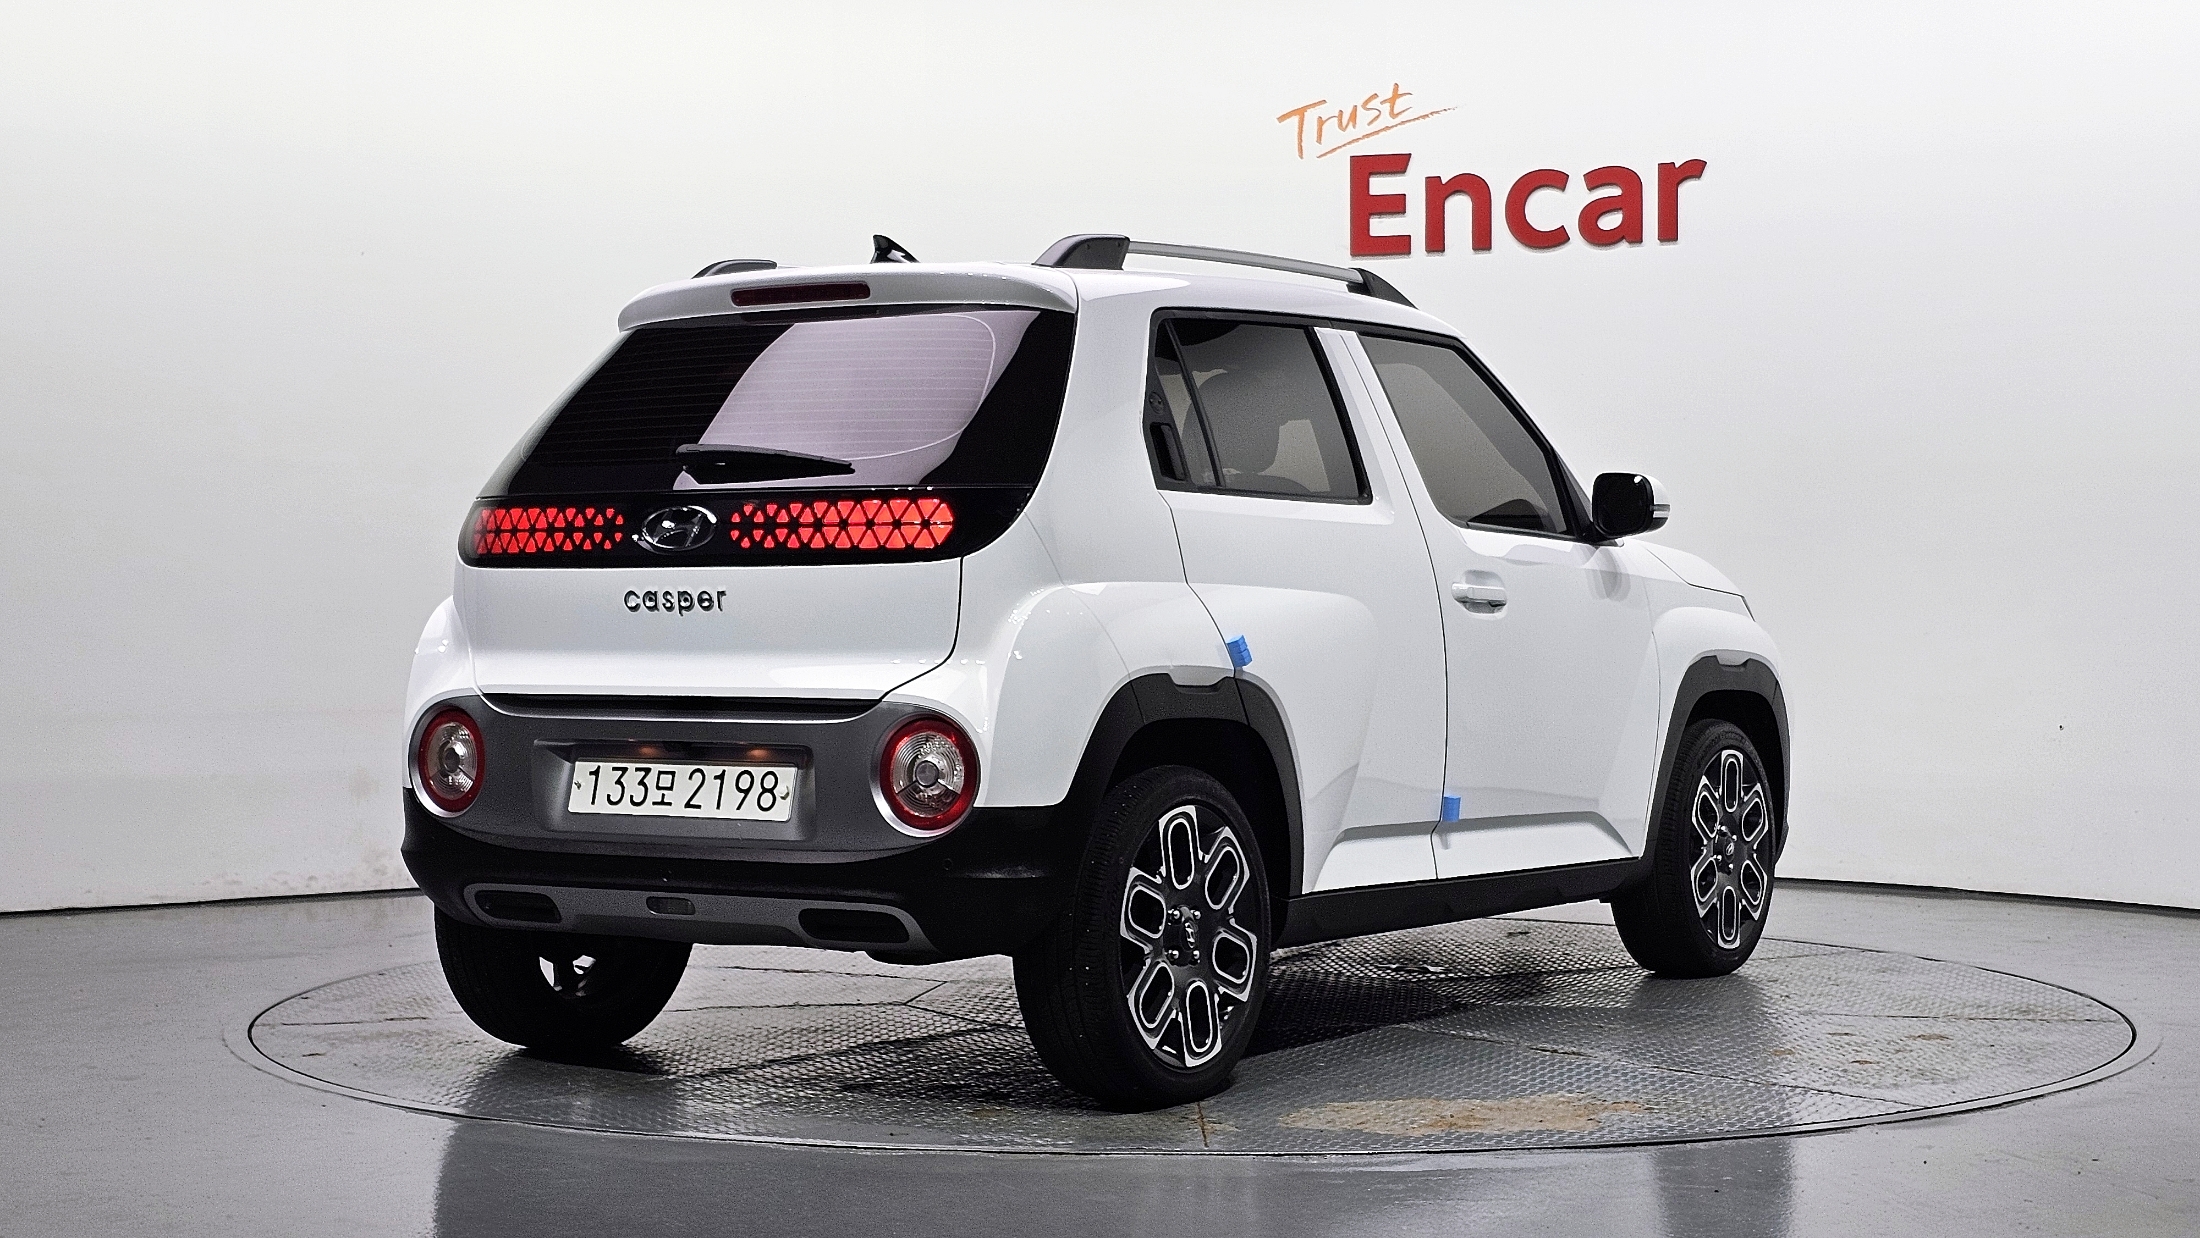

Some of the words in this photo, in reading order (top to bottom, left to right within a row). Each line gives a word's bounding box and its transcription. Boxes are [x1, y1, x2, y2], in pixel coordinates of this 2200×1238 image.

[1277, 83, 1413, 159] Trust
[1350, 153, 1708, 257] Encar
[624, 590, 727, 617] casper
